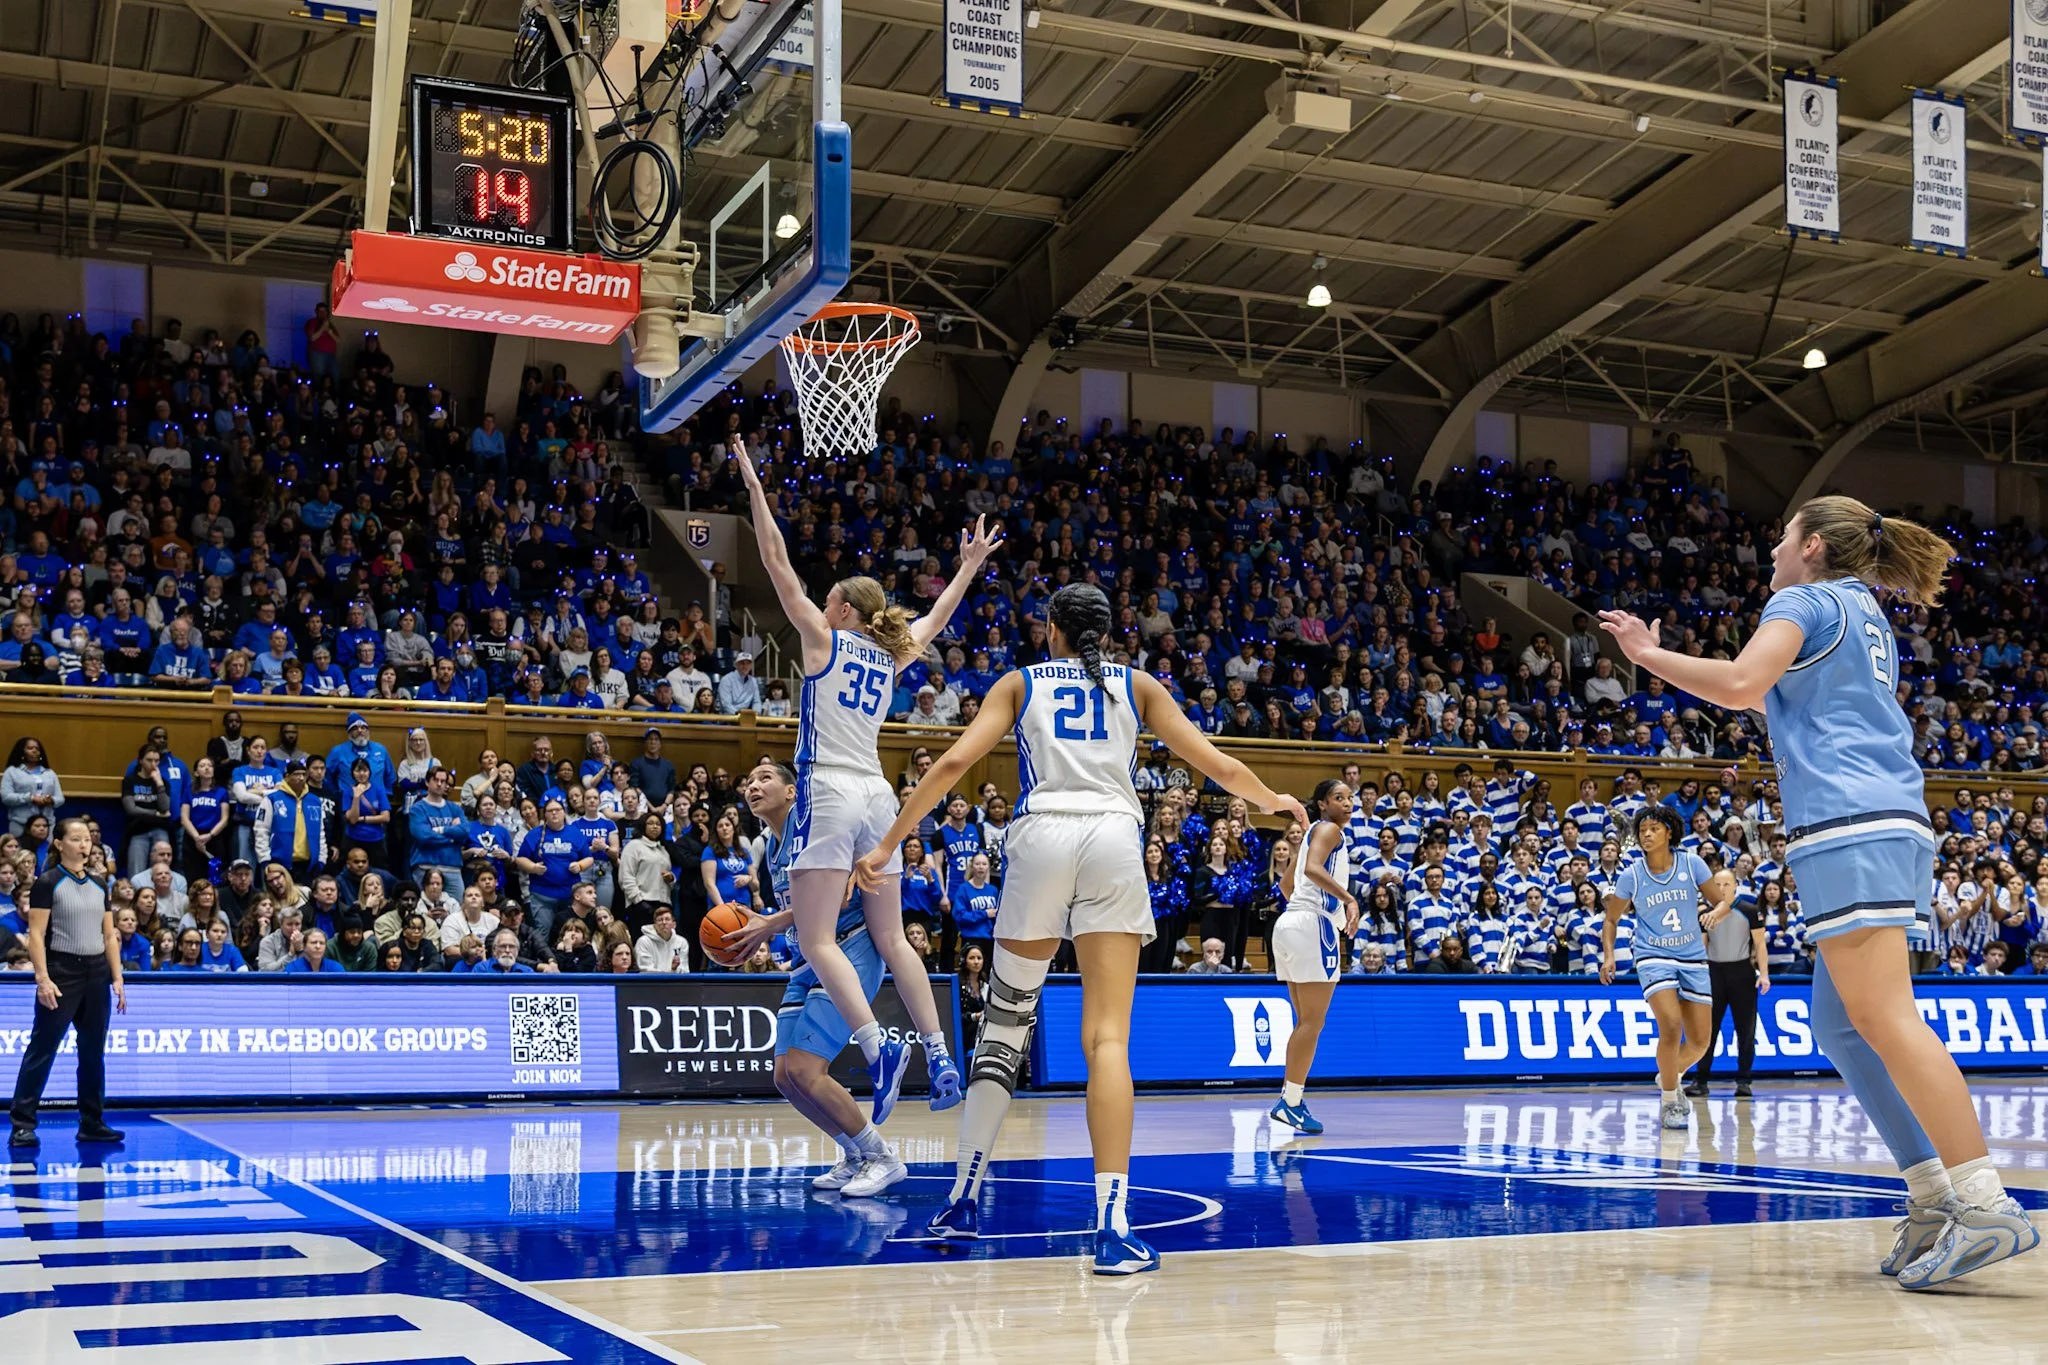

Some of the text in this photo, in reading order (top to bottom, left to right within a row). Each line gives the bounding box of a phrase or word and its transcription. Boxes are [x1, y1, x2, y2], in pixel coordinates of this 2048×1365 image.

[967, 9, 1002, 26] COAST
[949, 22, 1020, 44] CONFERENCE
[952, 38, 1017, 59] CHAMPIONS
[963, 58, 1006, 72] TOURNAMENT
[969, 75, 1000, 91] 2005
[459, 110, 549, 164] 5:20
[1795, 138, 1829, 154] ATLANTIC
[1800, 152, 1825, 166] COAST
[1922, 155, 1957, 171] ATLANTIC
[1788, 163, 1837, 182] CONFERENCE
[1929, 168, 1952, 183] COAST
[1791, 177, 1835, 195] CHAMPIONS
[1914, 181, 1963, 199] CONFERENCE
[476, 170, 530, 225] 14
[1917, 194, 1962, 211] CHAMPIONS
[1803, 209, 1824, 223] 2006
[448, 226, 546, 246] AKTRONICS
[1930, 223, 1950, 238] 2009
[691, 526, 708, 544] 15
[838, 638, 895, 668] FOURNIER
[1863, 620, 1893, 694] 21
[165, 664, 196, 679] BEST
[1032, 666, 1124, 680] ROBERON
[838, 661, 888, 717] 35
[1053, 686, 1108, 741] 21
[192, 796, 217, 808] DUKE
[320, 796, 336, 816] KE
[948, 840, 979, 855] DUKE
[1646, 889, 1689, 908] NORTH
[1661, 908, 1682, 932] 4
[1648, 931, 1696, 947] CAROLINA
[1459, 998, 1660, 1061] DUKE
[136, 1028, 192, 1053] DAY
[200, 1028, 230, 1053] IN
[237, 1028, 377, 1053] FACEBOOK
[384, 1027, 488, 1051] GROUPS
[664, 1059, 774, 1073] JEWELERS
[511, 1068, 582, 1084] JOIN NOW
